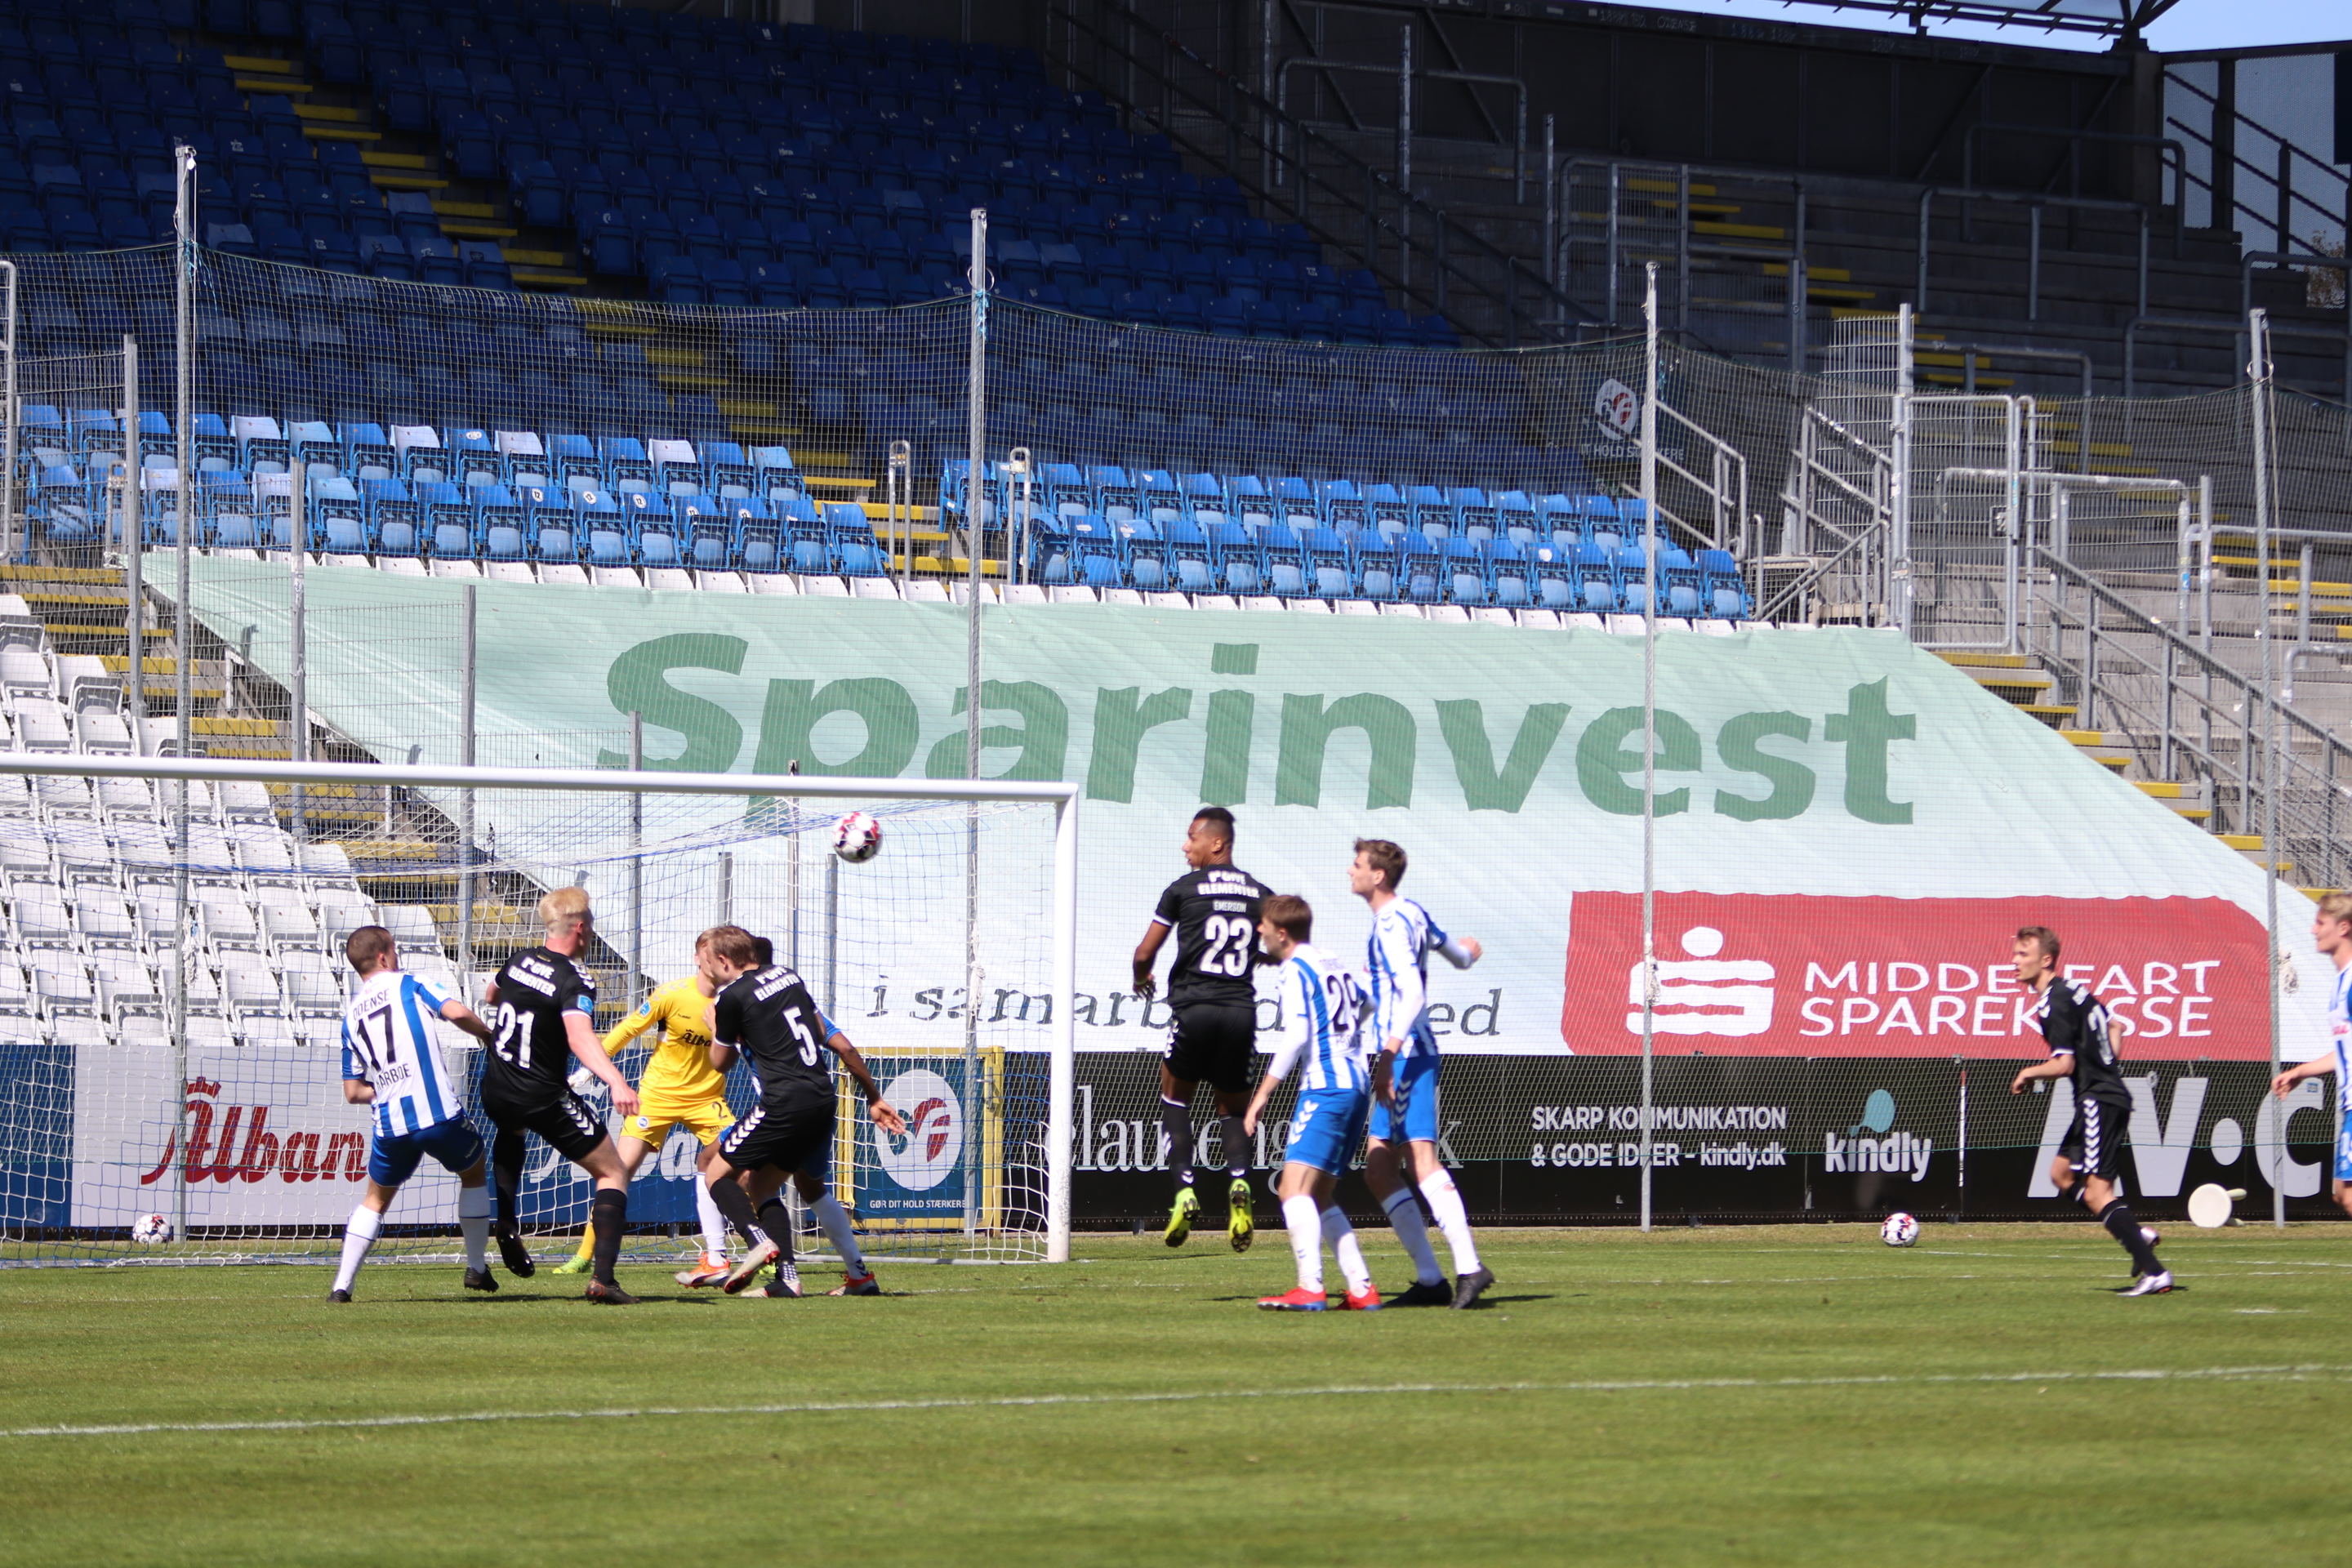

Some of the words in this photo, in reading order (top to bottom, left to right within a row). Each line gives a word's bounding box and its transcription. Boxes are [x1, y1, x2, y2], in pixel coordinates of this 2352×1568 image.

[597, 632, 1916, 831] Sparinvest
[1213, 899, 1247, 913] EMERSON
[1200, 914, 1253, 977] 23
[1804, 960, 2221, 996] MIDDEFART
[353, 988, 390, 1022] ODENSE
[866, 973, 889, 1018] i
[1427, 988, 1502, 1037] ed
[1799, 996, 2213, 1037] SPAREKSSE
[357, 1004, 397, 1072] 17
[495, 1001, 535, 1069] 21
[678, 1031, 712, 1046] Alba
[782, 1006, 817, 1067] 5
[1532, 1106, 1604, 1130] SKARP
[140, 1099, 368, 1185] Alban
[1531, 1143, 1546, 1167] &
[1552, 1143, 1613, 1167] GODE
[1700, 1141, 1786, 1171] kindly.dk
[1824, 1131, 1932, 1183] kindly
[870, 1200, 888, 1209] GØR
[889, 1200, 902, 1209] DIT
[903, 1200, 924, 1209] HOLD
